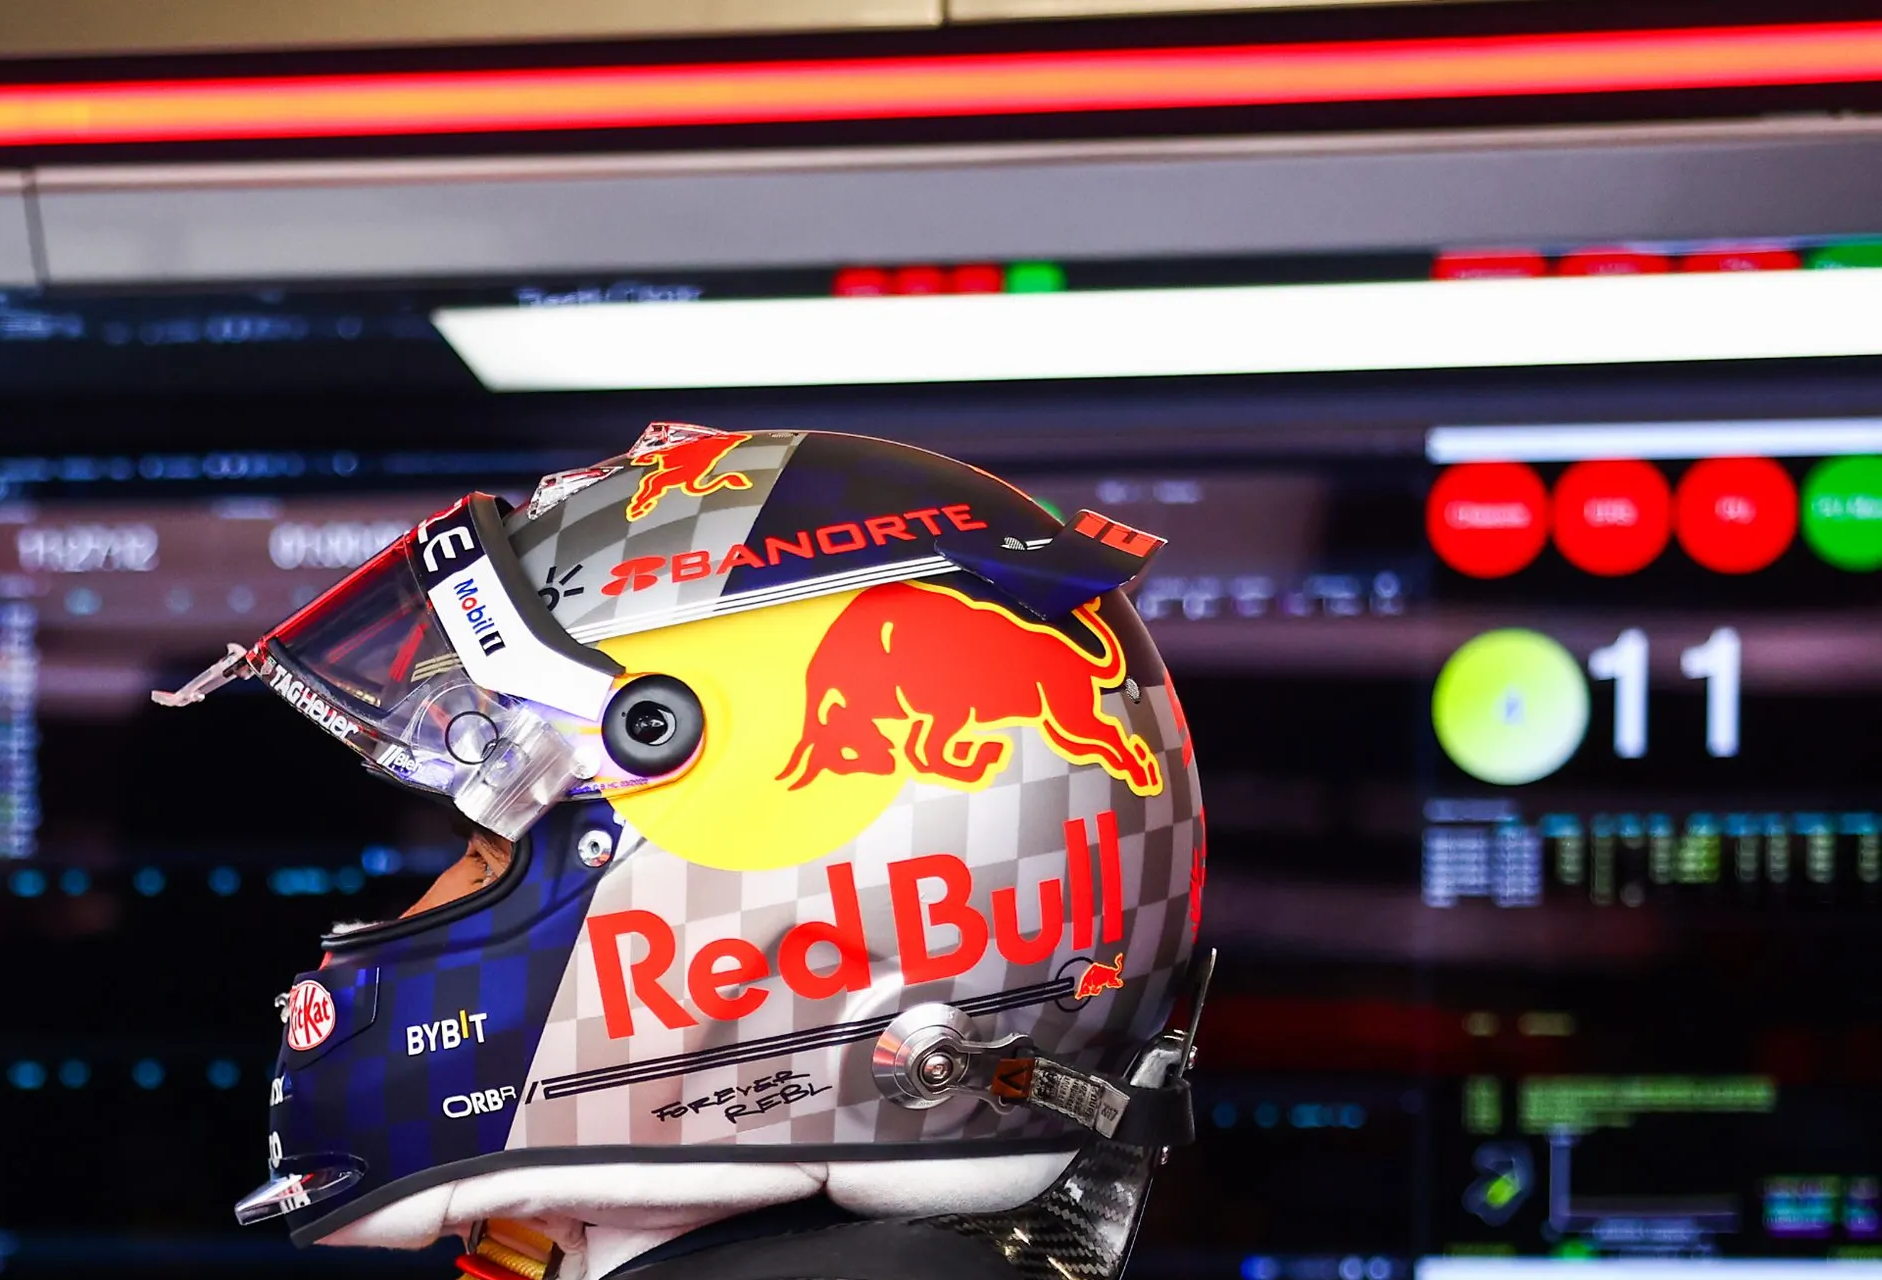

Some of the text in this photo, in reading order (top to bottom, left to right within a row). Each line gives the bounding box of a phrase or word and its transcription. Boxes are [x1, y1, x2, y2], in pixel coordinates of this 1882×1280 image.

[670, 504, 988, 581] BANORTE
[453, 578, 495, 635] Mobil
[586, 865, 873, 1040] Red
[887, 810, 1124, 987] Bull
[406, 1009, 488, 1056] BYBIT
[651, 1070, 811, 1122] FOREVER
